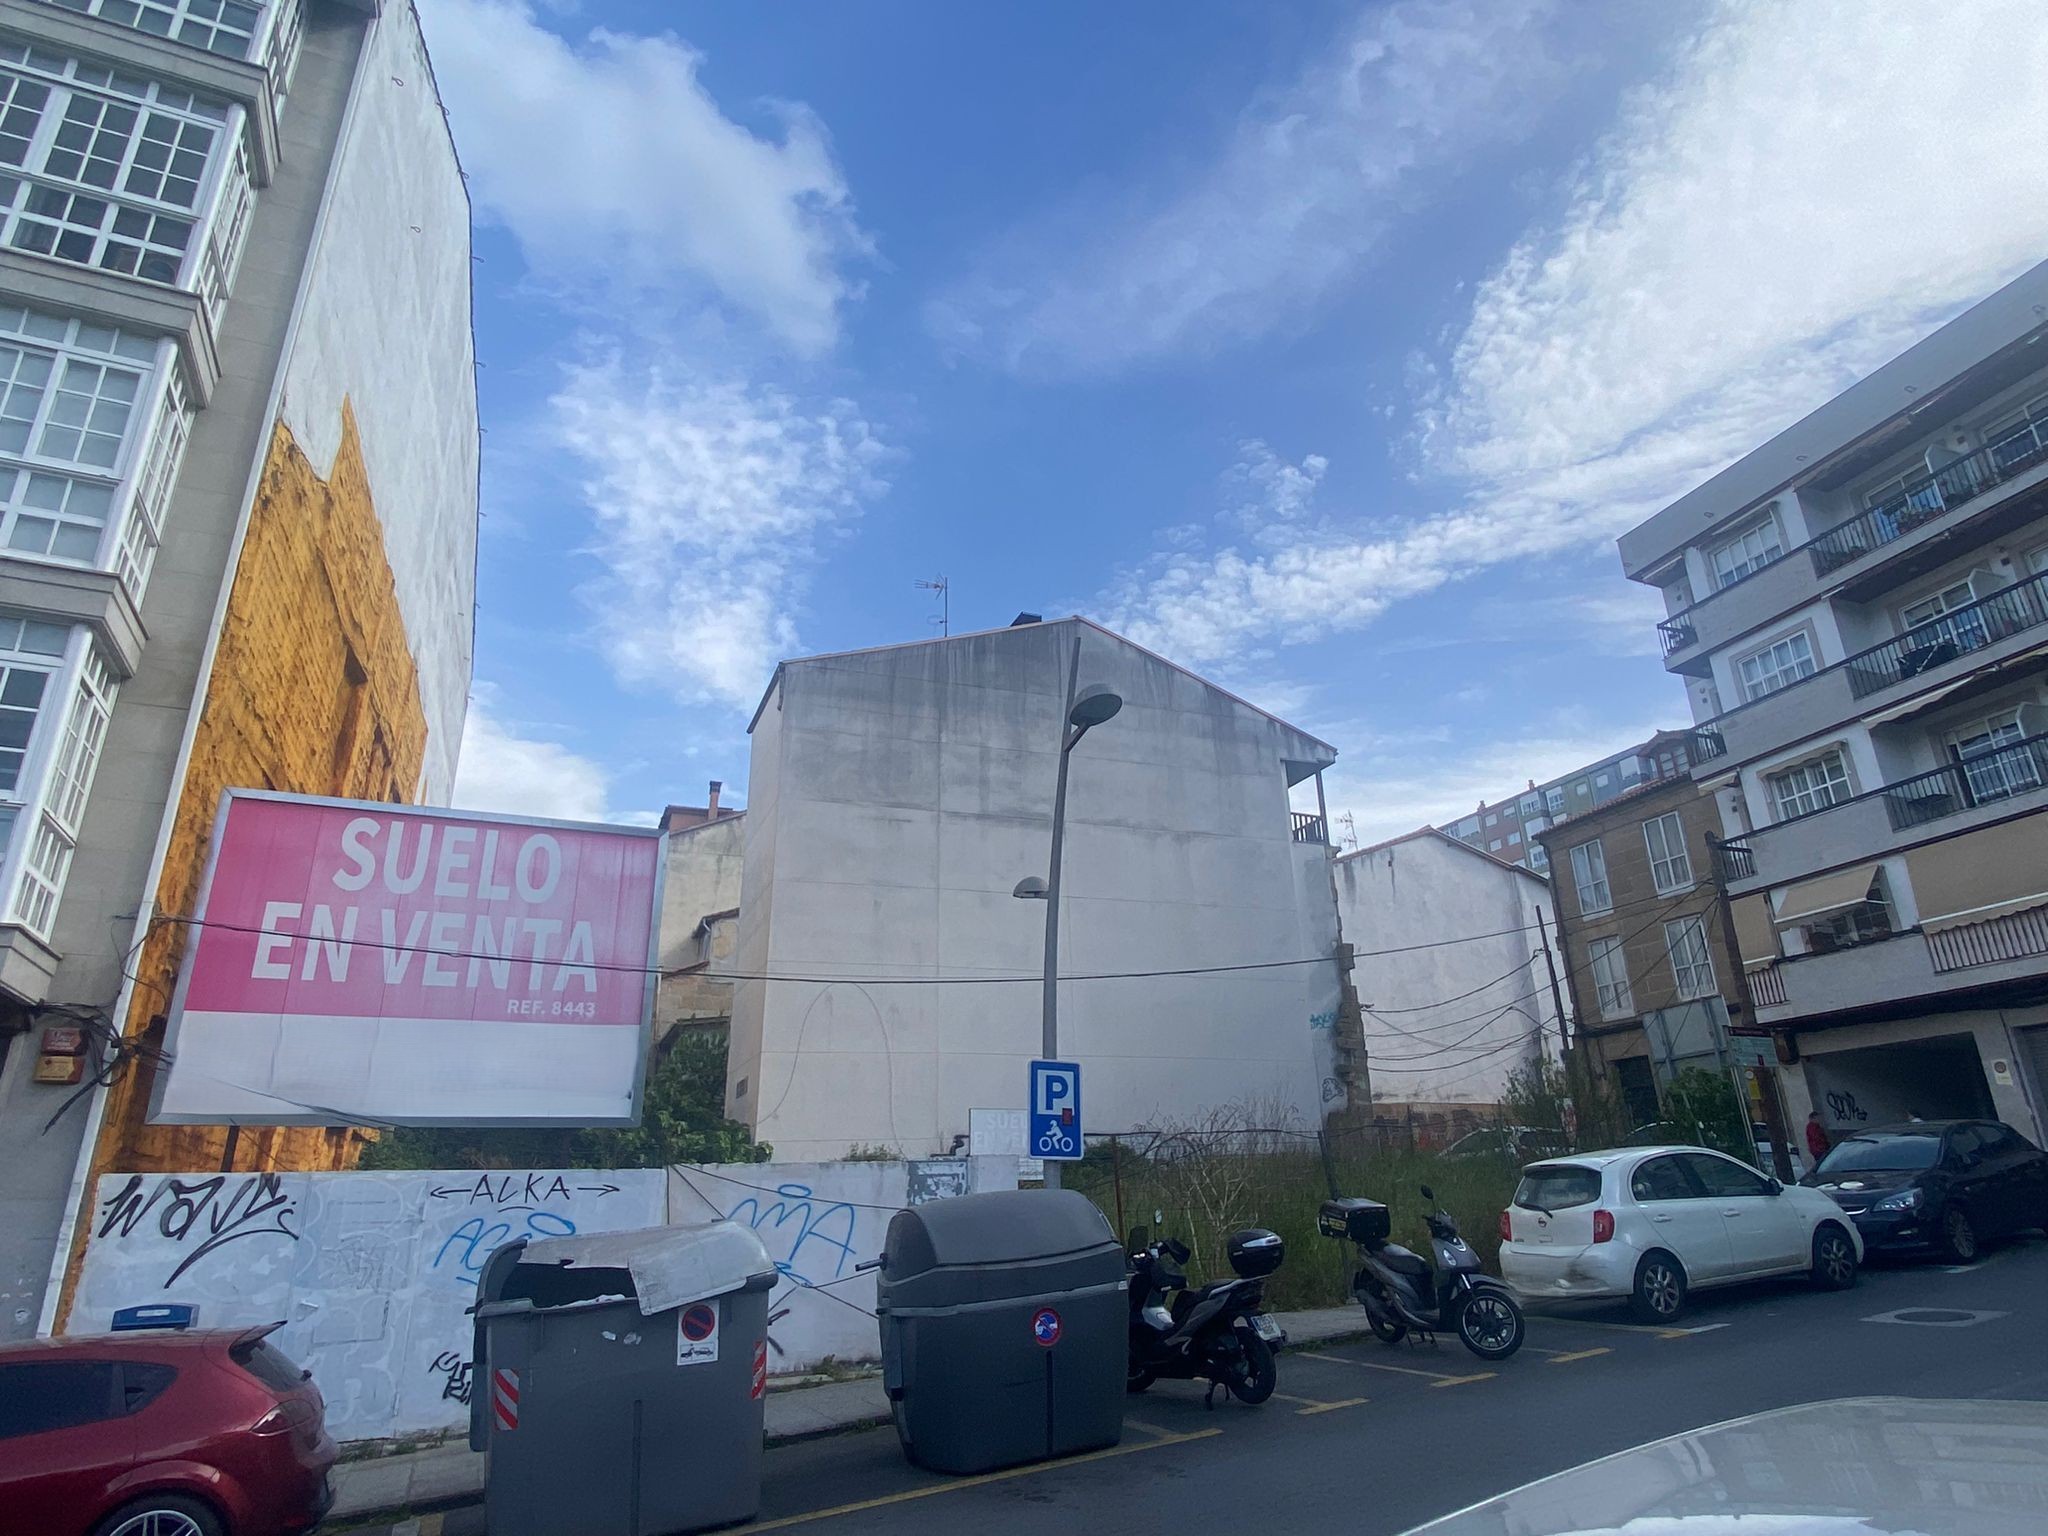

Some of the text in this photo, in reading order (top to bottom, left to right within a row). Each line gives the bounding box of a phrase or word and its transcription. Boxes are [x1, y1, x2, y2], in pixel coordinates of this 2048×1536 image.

[332, 817, 562, 904] SUELO
[251, 901, 598, 994] EN VENTA
[507, 999, 596, 1018] REF. 8443
[1045, 1074, 1069, 1111] P
